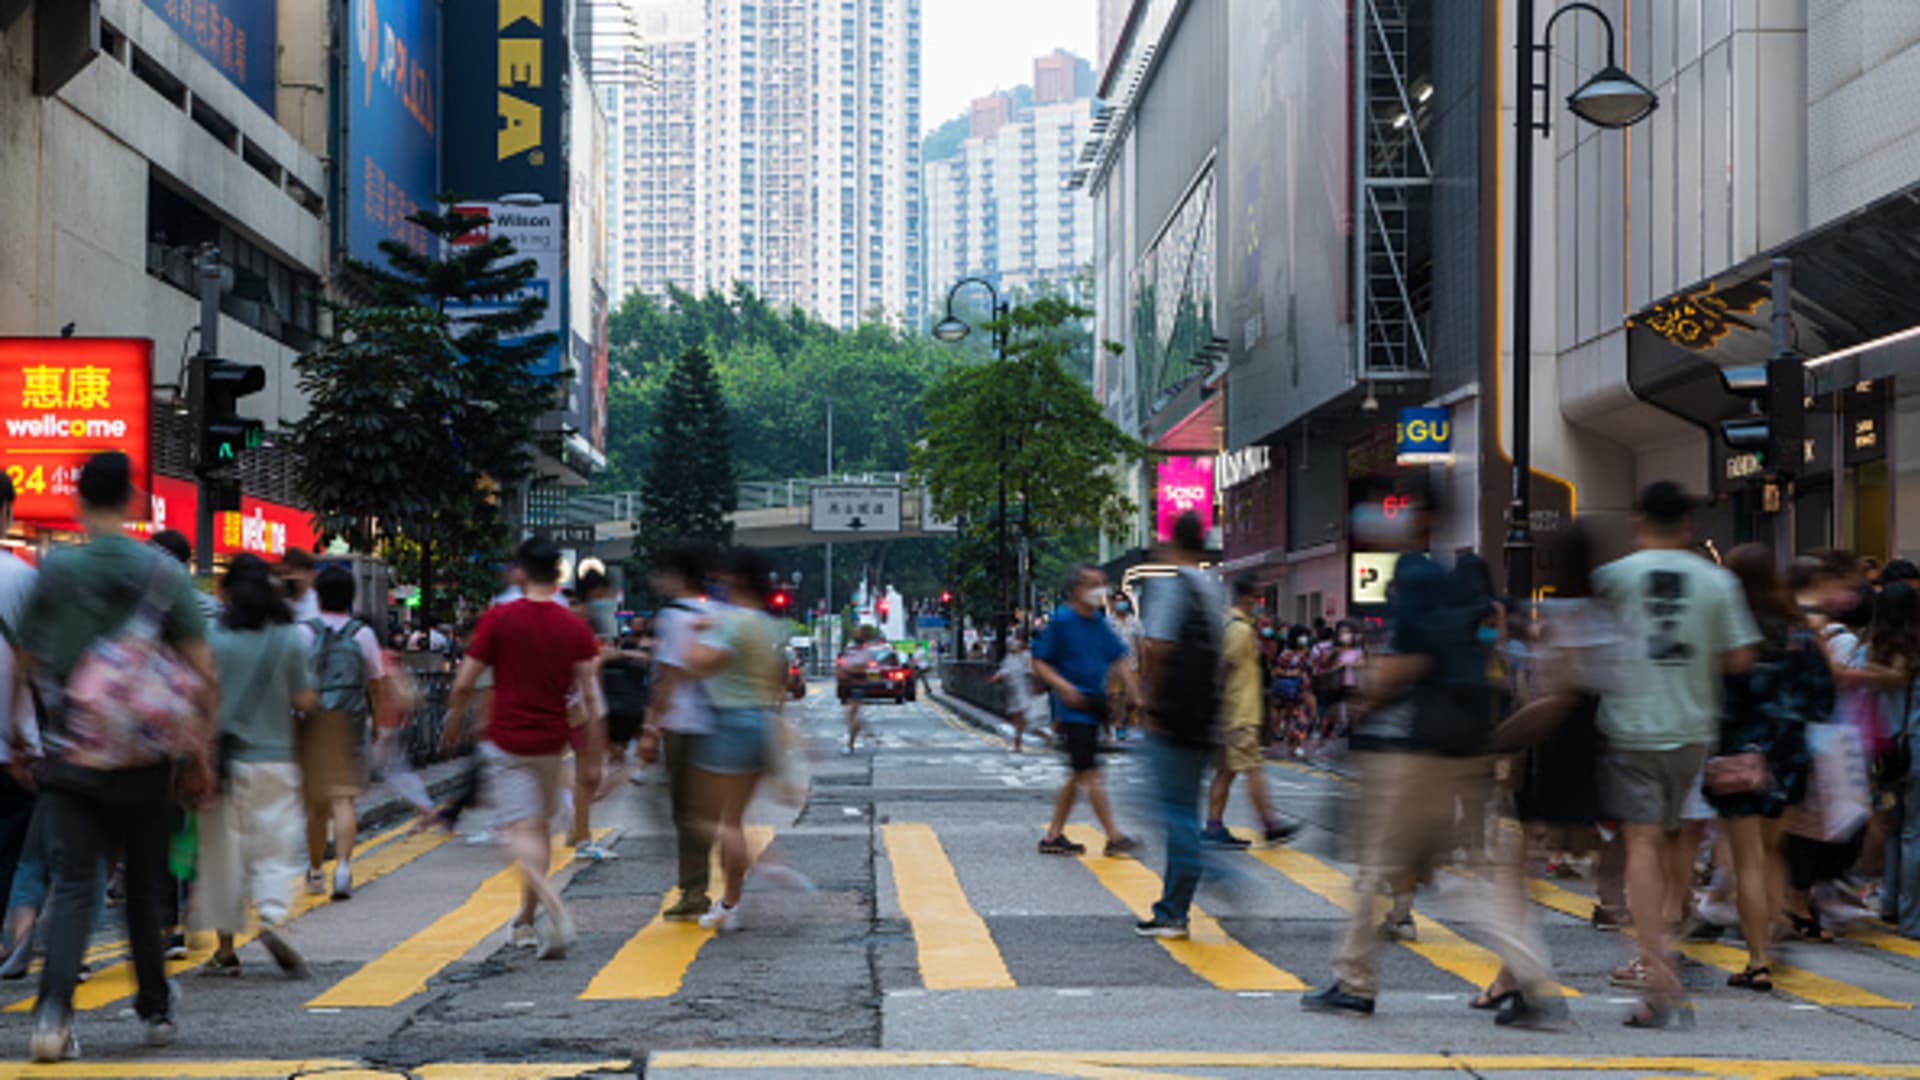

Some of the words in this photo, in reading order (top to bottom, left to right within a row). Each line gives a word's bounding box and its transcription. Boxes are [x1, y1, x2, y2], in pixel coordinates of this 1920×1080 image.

[497, 213, 551, 227] Wilson
[22, 364, 111, 409] 惠康
[6, 414, 127, 437] wellcome
[6, 465, 47, 494] 24
